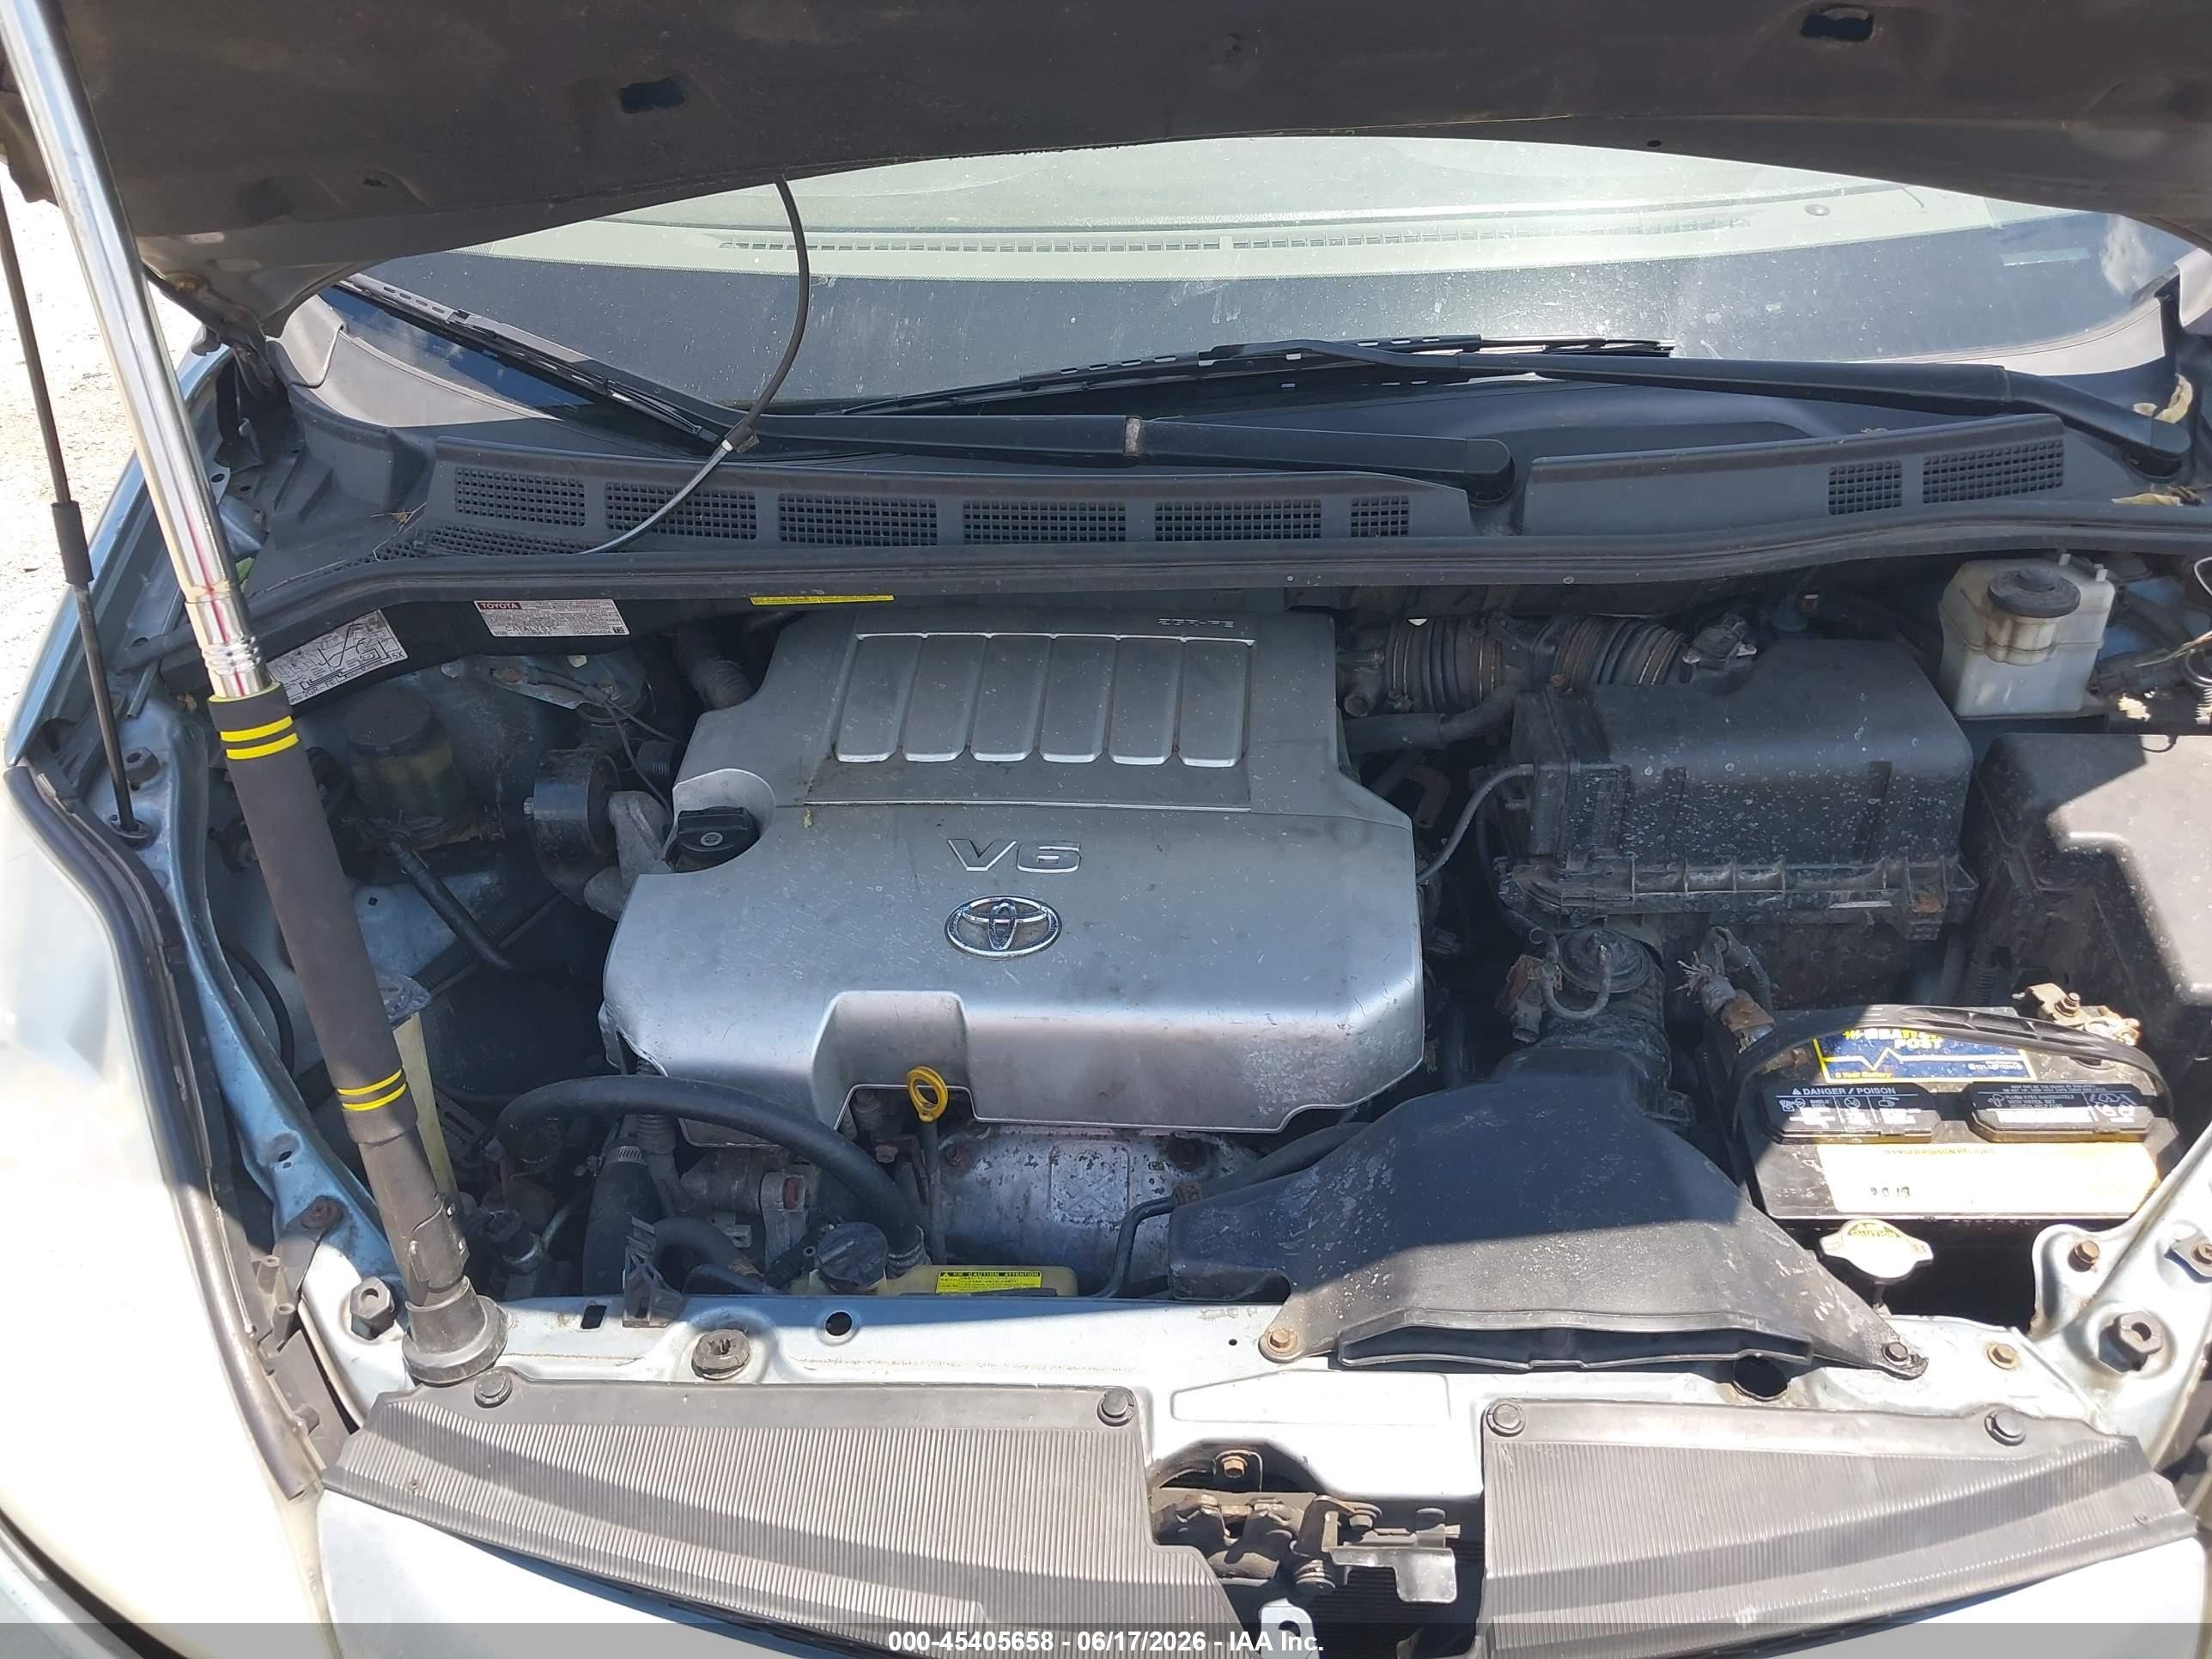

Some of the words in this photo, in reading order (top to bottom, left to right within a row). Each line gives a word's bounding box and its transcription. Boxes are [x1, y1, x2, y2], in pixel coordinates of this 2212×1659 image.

[391, 651, 404, 660] 5X
[946, 838, 1082, 873] V6
[1893, 1038, 1944, 1050] POST
